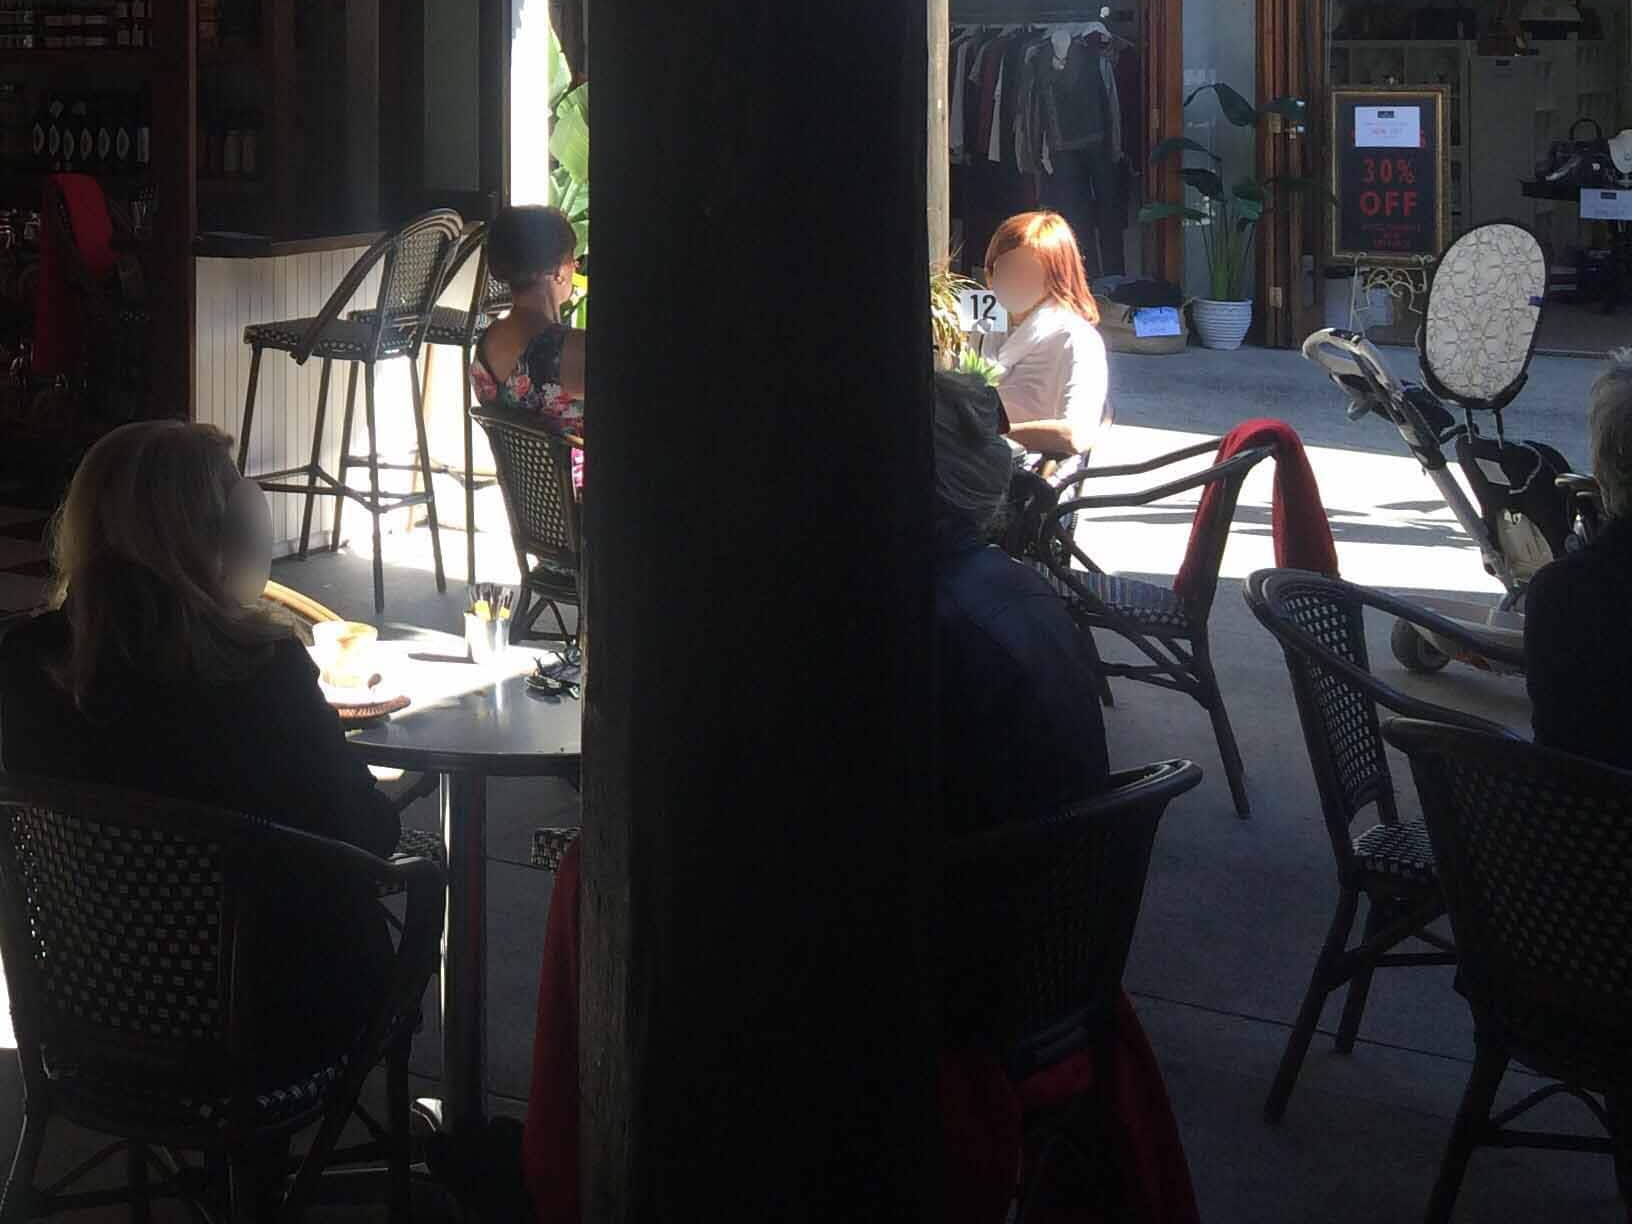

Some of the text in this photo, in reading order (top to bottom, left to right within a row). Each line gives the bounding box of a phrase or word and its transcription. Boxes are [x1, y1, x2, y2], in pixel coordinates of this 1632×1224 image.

[1362, 158, 1416, 185] 30%
[1359, 190, 1418, 217] OFF
[969, 293, 998, 321] 12
